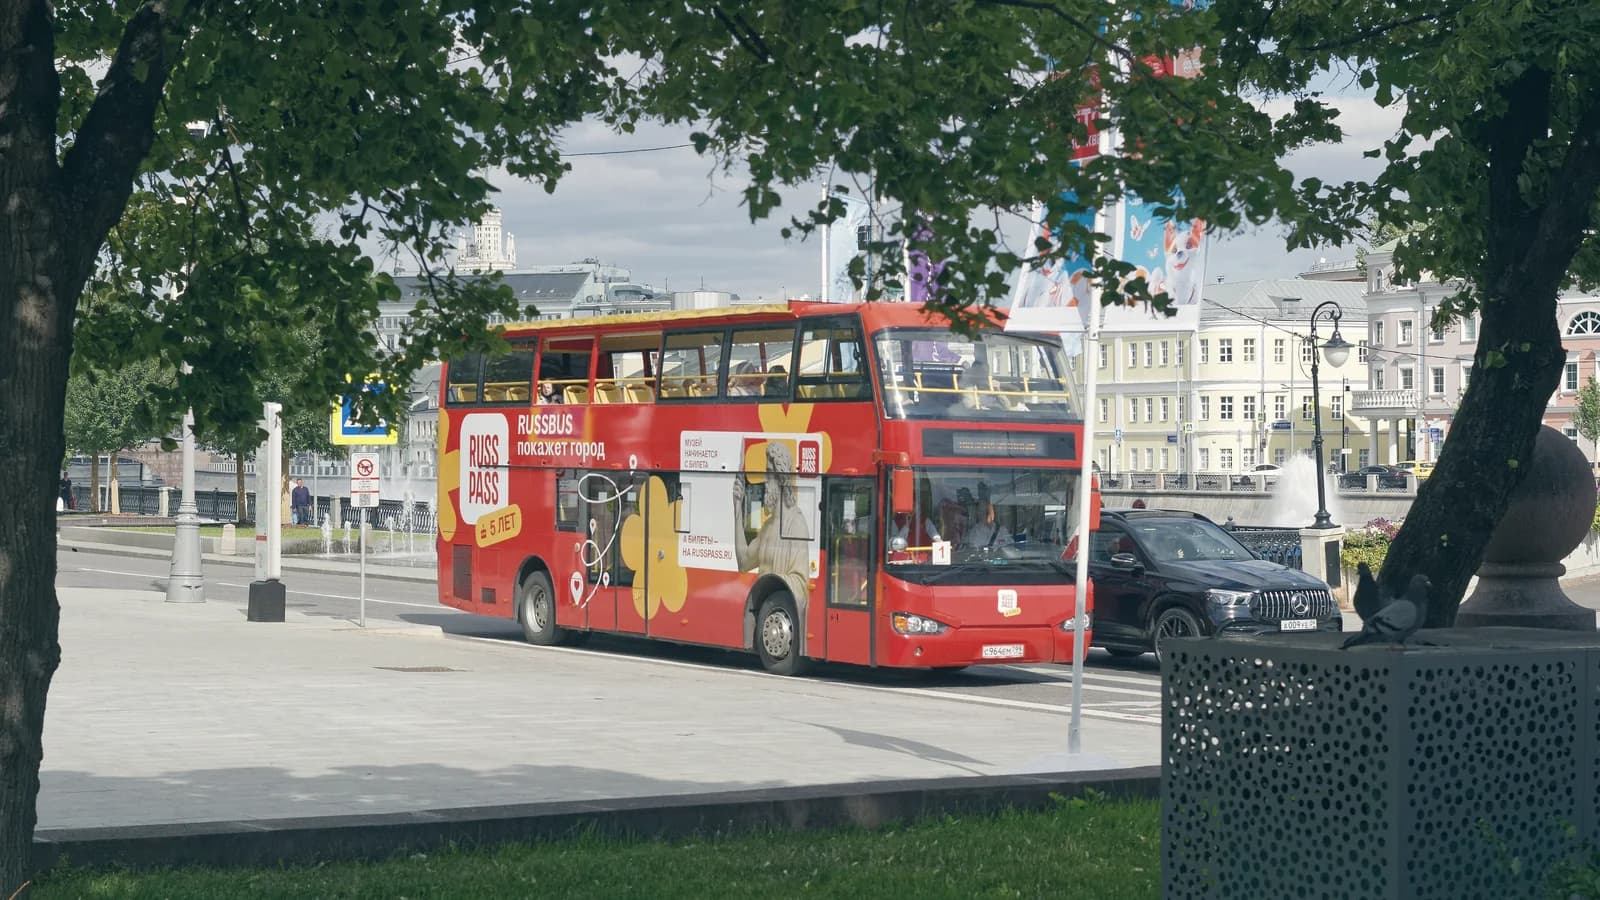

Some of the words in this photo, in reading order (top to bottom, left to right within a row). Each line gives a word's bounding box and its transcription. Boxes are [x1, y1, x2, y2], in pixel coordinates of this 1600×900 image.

[517, 413, 573, 435] RUSSBUS
[469, 434, 499, 469] RUSS
[517, 440, 568, 456] покажет
[570, 441, 605, 461] город
[469, 471, 499, 505] PASS
[489, 519, 496, 536] 5
[498, 512, 516, 533] ЛЕТ
[691, 548, 733, 560] RUSSPASS.RU
[938, 546, 944, 559] 1
